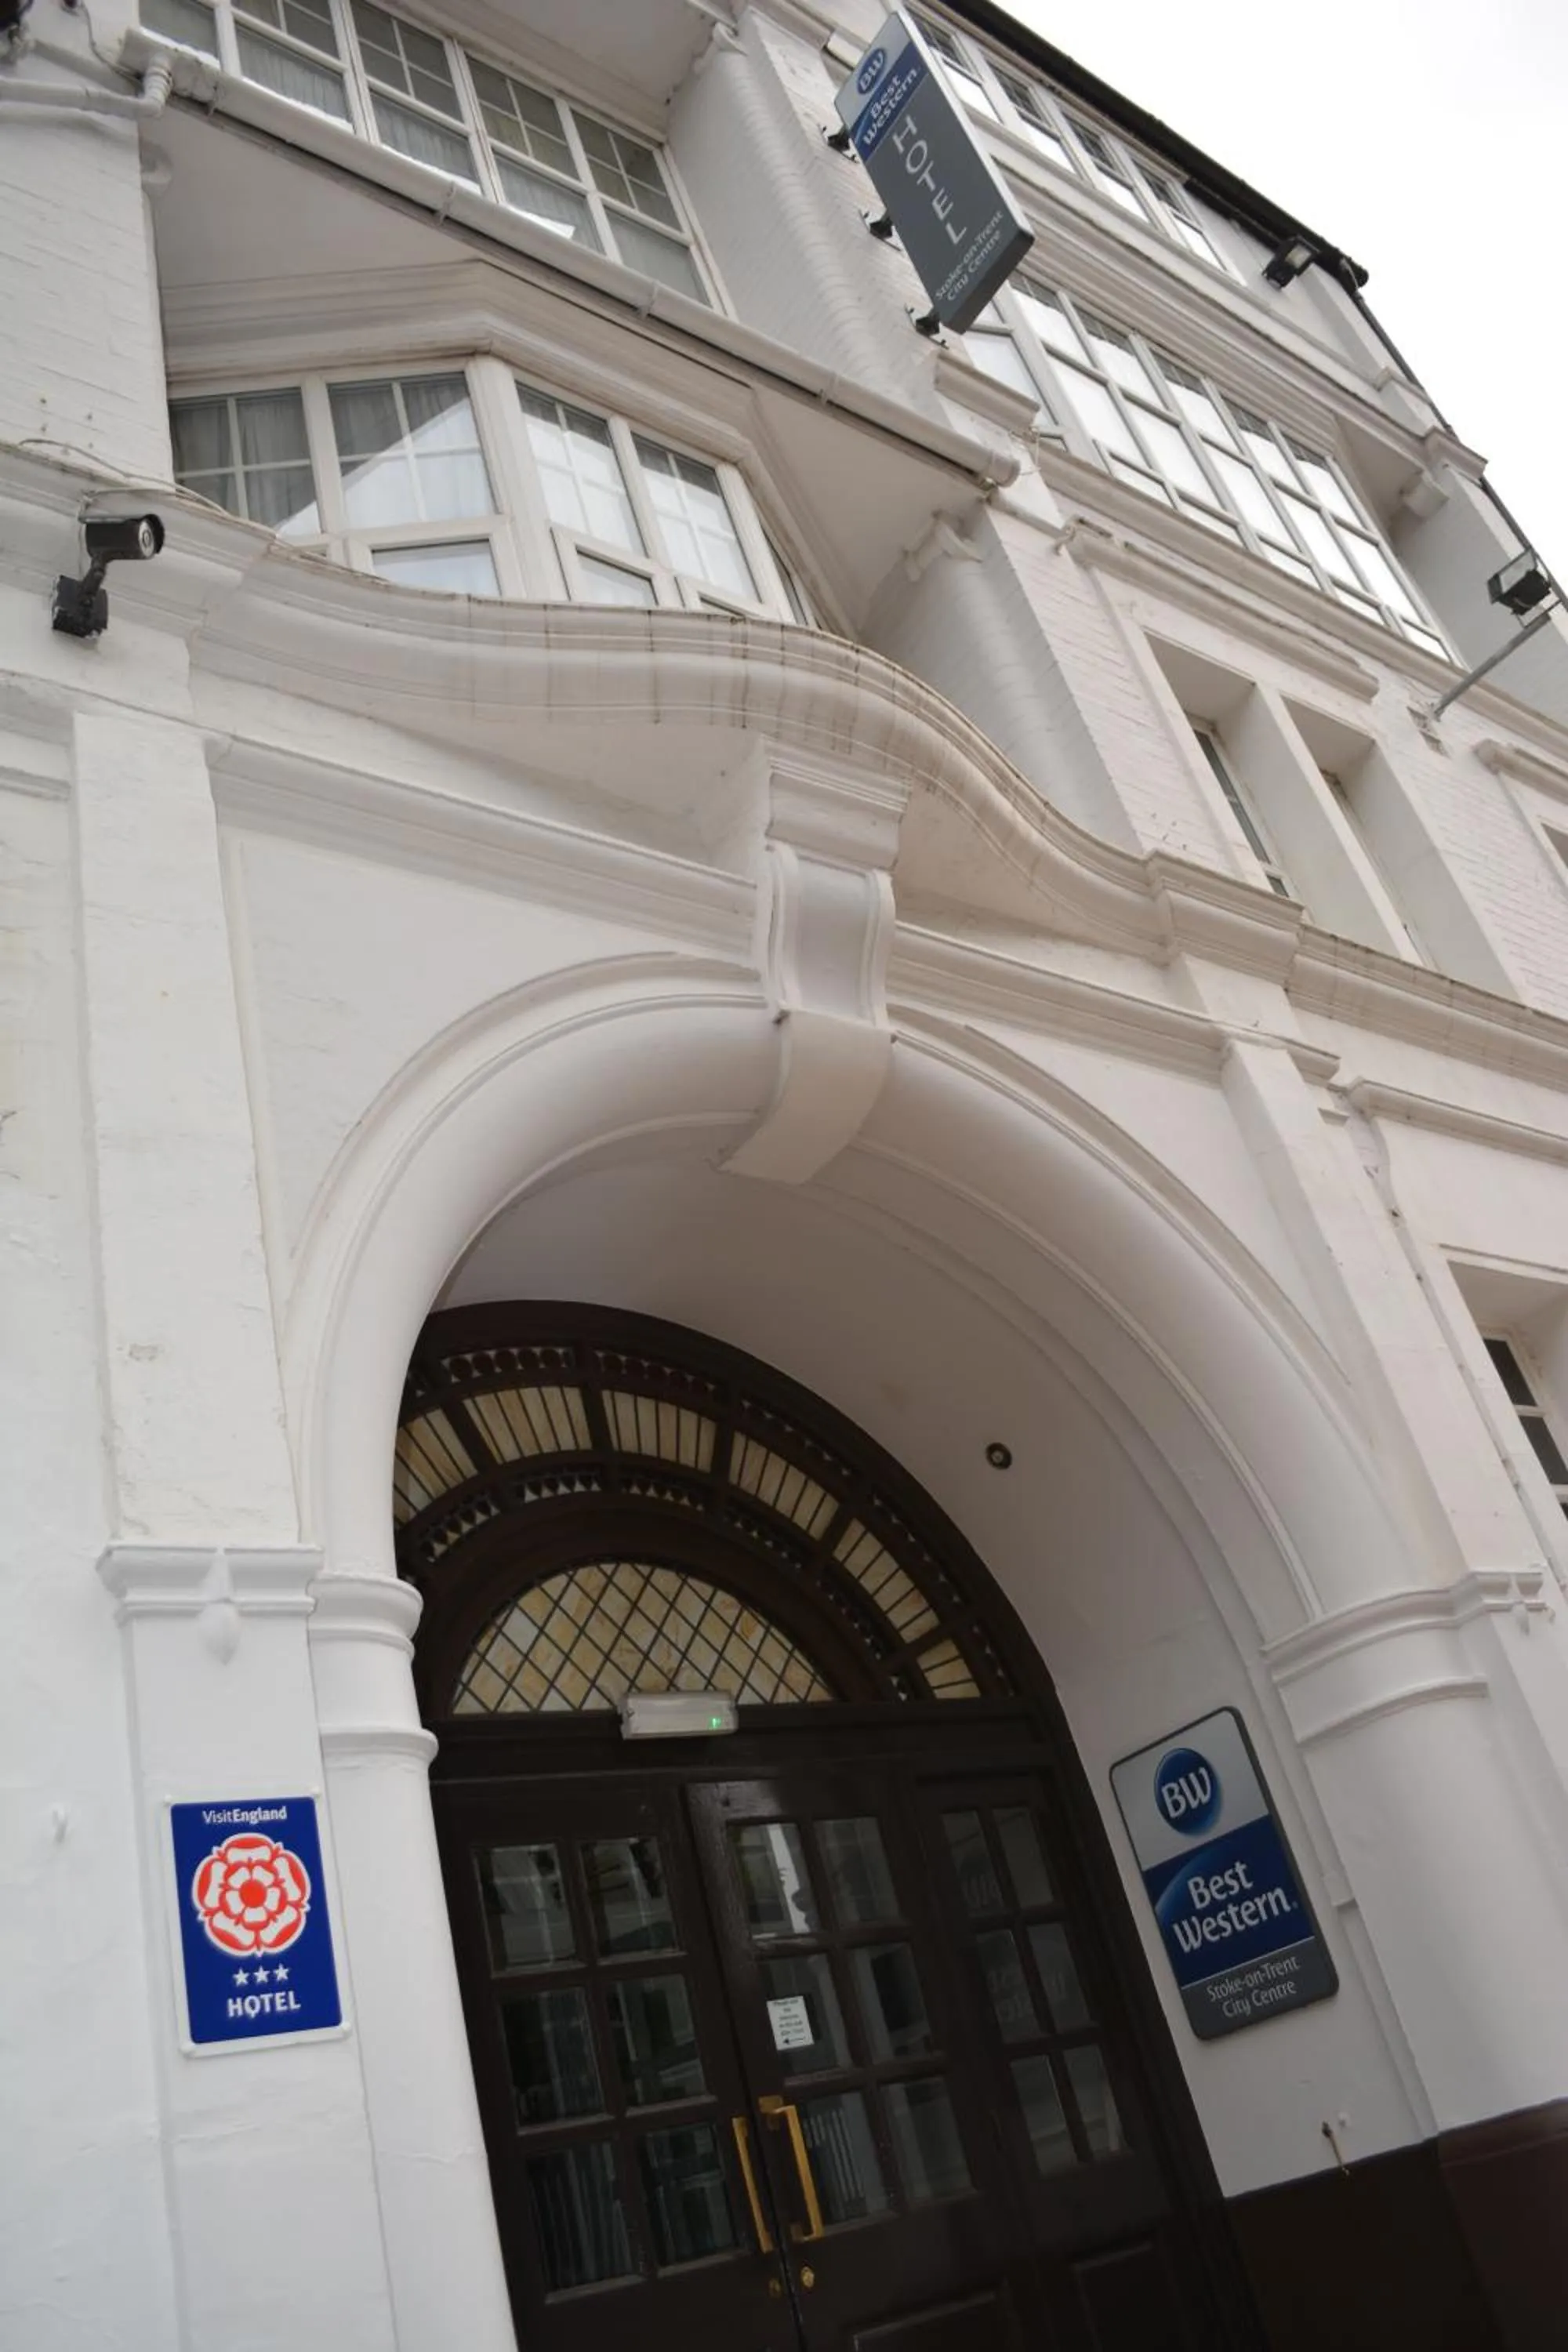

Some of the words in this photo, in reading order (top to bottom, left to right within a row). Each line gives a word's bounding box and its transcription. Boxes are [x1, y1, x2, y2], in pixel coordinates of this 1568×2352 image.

[863, 68, 916, 144] Western
[870, 75, 900, 118] Best
[892, 114, 967, 245] HOTEL
[201, 1806, 288, 1824] VisitEngland
[1161, 1766, 1212, 1819] BW
[1187, 1860, 1253, 1909] Best
[1173, 1887, 1291, 1953] Western
[1207, 1957, 1300, 2002] Stoke-on-Trent
[1222, 1998, 1251, 2017] City
[1251, 1980, 1297, 2007] Centre
[227, 1991, 301, 2018] HOTEL
